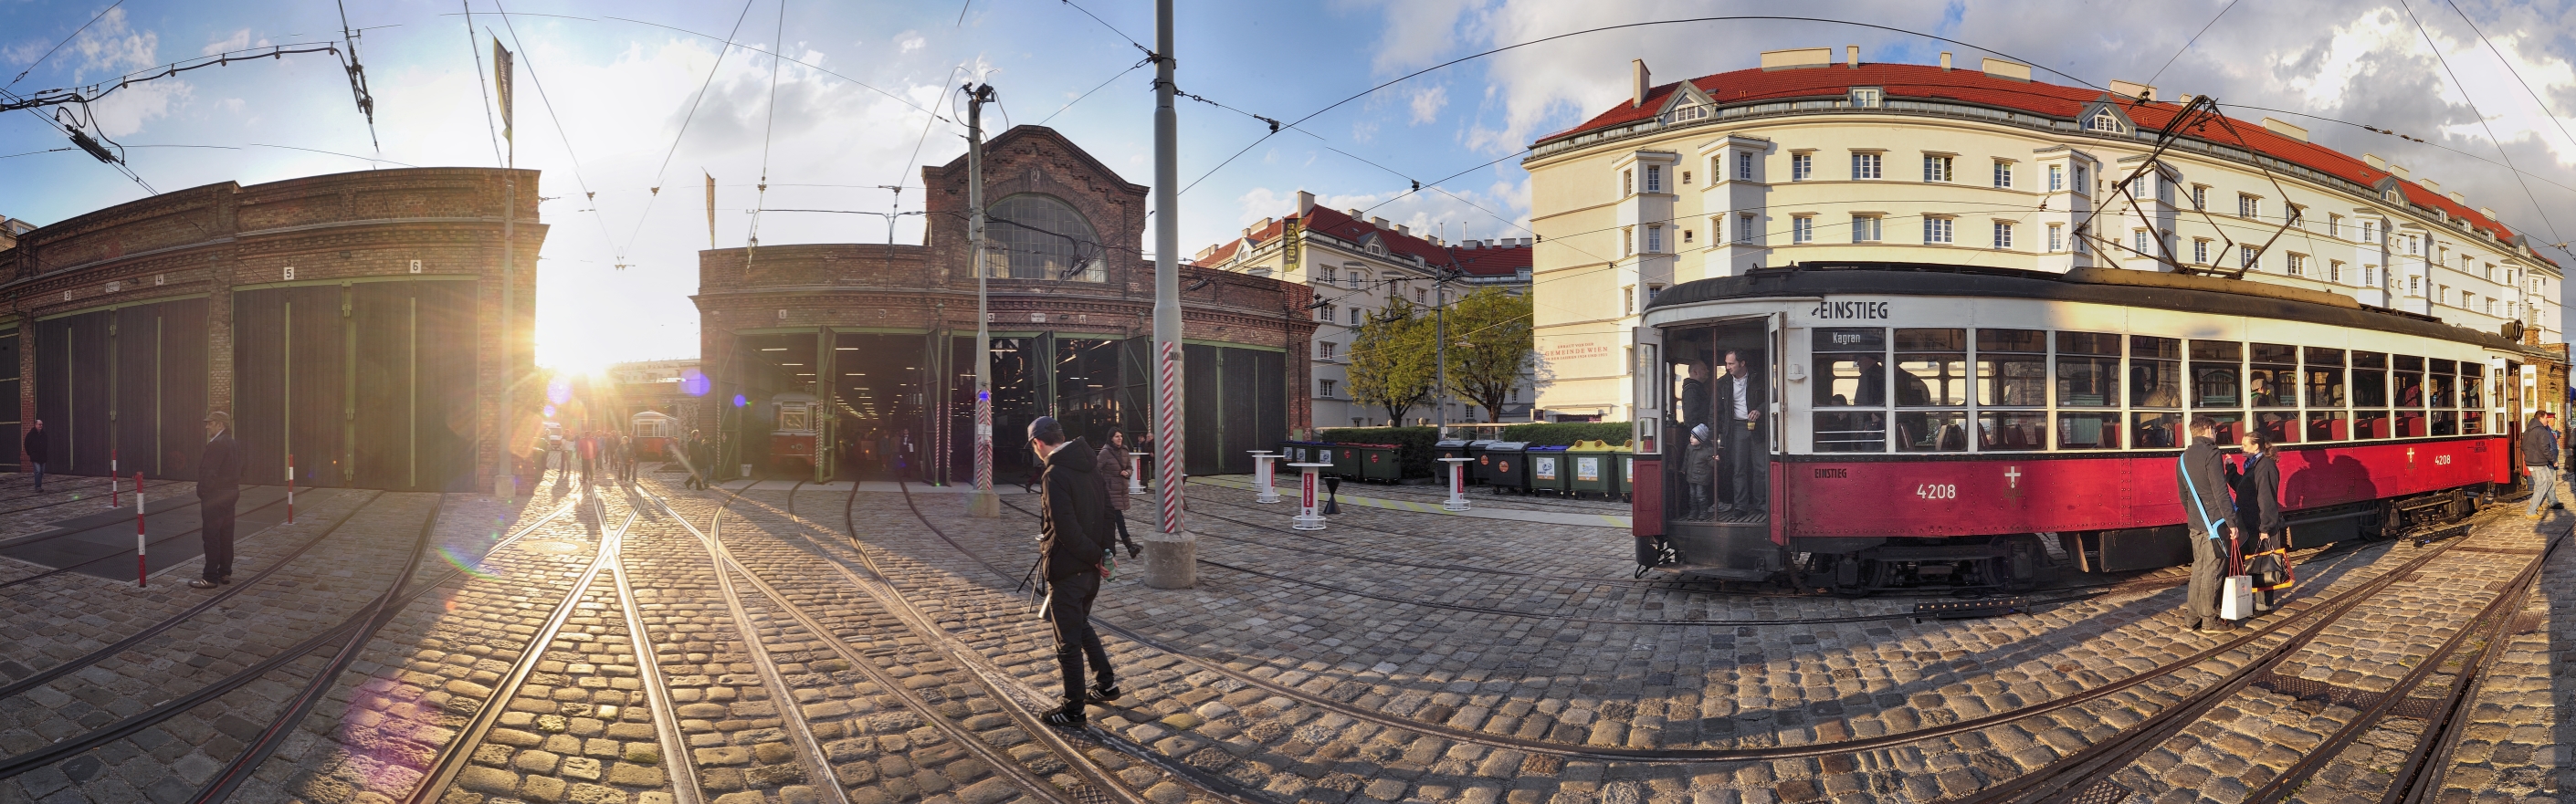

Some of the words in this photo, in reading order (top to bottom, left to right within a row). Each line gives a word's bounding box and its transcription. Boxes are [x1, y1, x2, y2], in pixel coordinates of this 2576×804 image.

[413, 262, 418, 271] 6
[286, 269, 292, 278] 5
[157, 276, 163, 284] 4
[1820, 301, 1887, 319] EINSTIEG
[2515, 322, 2523, 337] 17
[1833, 331, 1860, 344] Kagran
[2434, 454, 2451, 465] 4208
[1814, 468, 1847, 479] EINSTIEG
[1917, 484, 1956, 499] 4208
